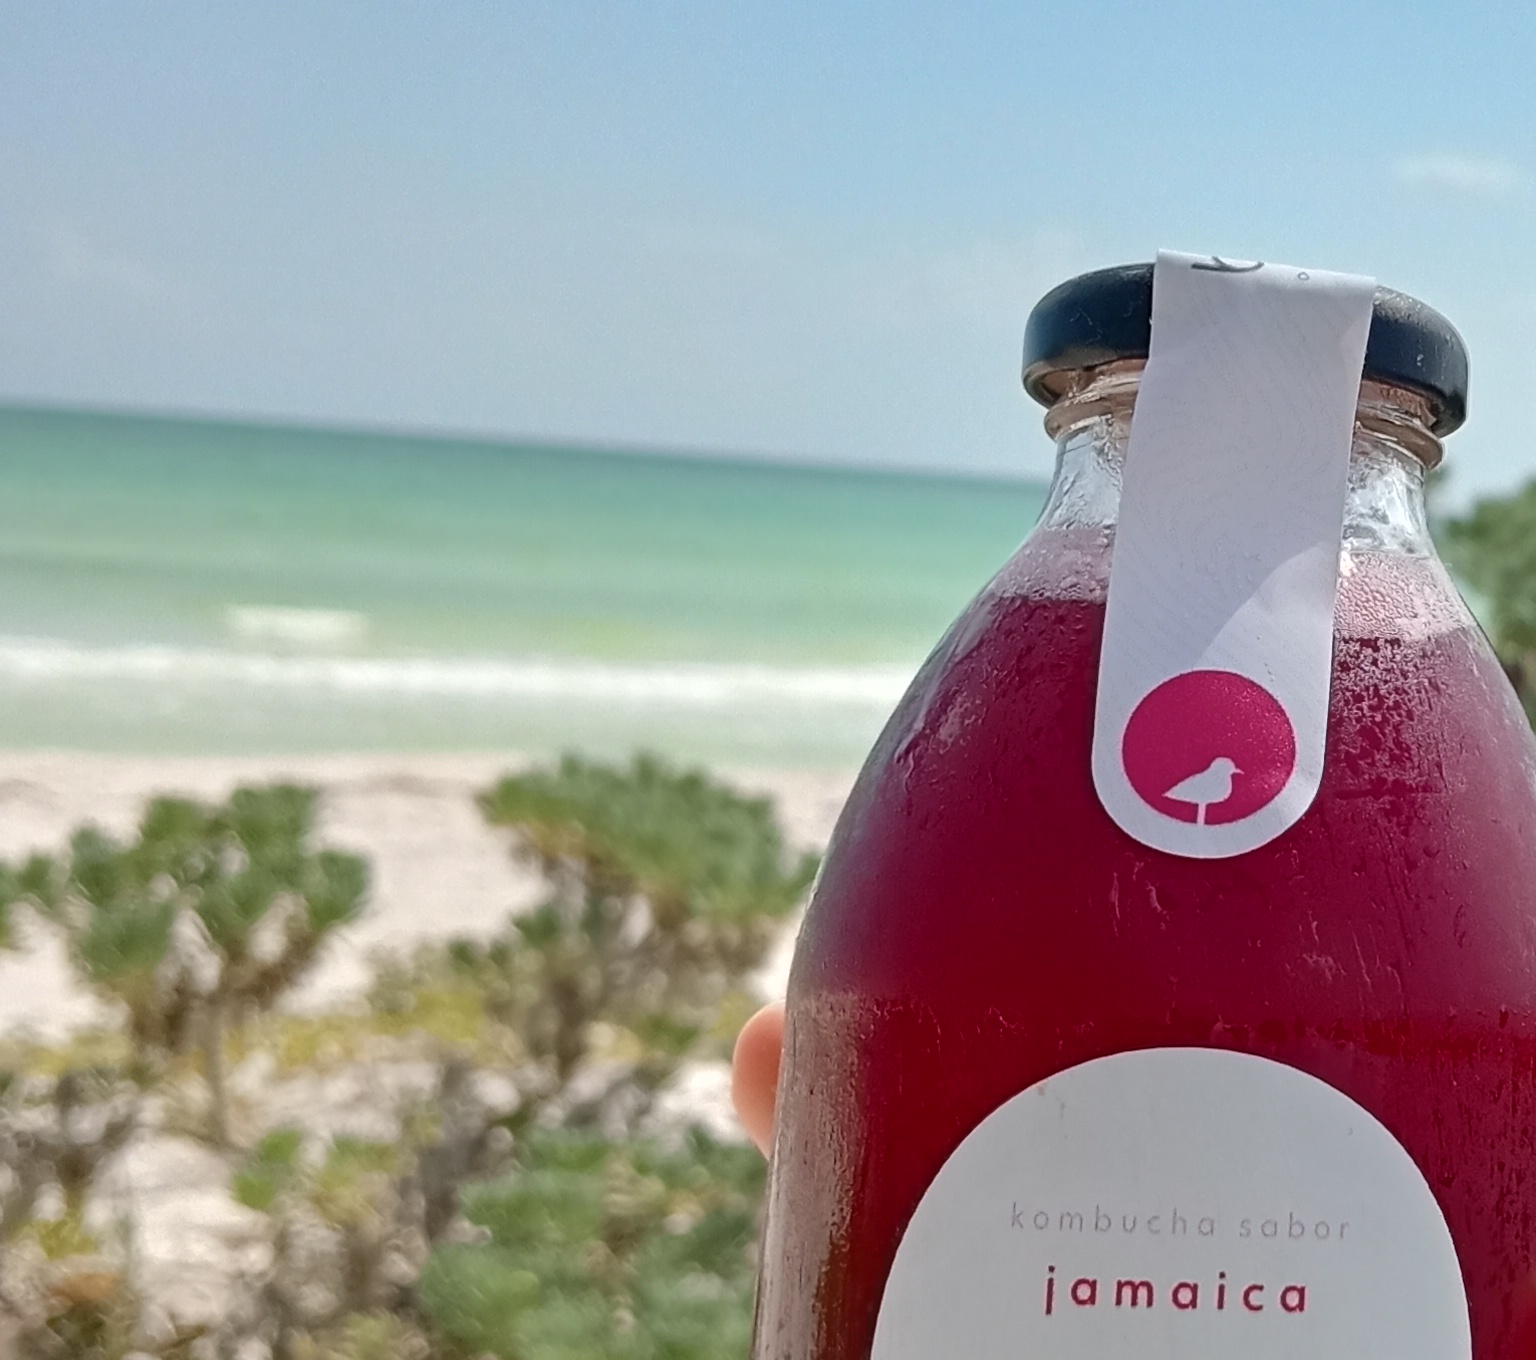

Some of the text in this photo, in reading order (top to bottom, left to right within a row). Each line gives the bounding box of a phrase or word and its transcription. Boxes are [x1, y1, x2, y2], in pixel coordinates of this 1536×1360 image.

[1010, 1202, 1351, 1240] kombucha sabor
[1044, 1265, 1307, 1316] jamaica
